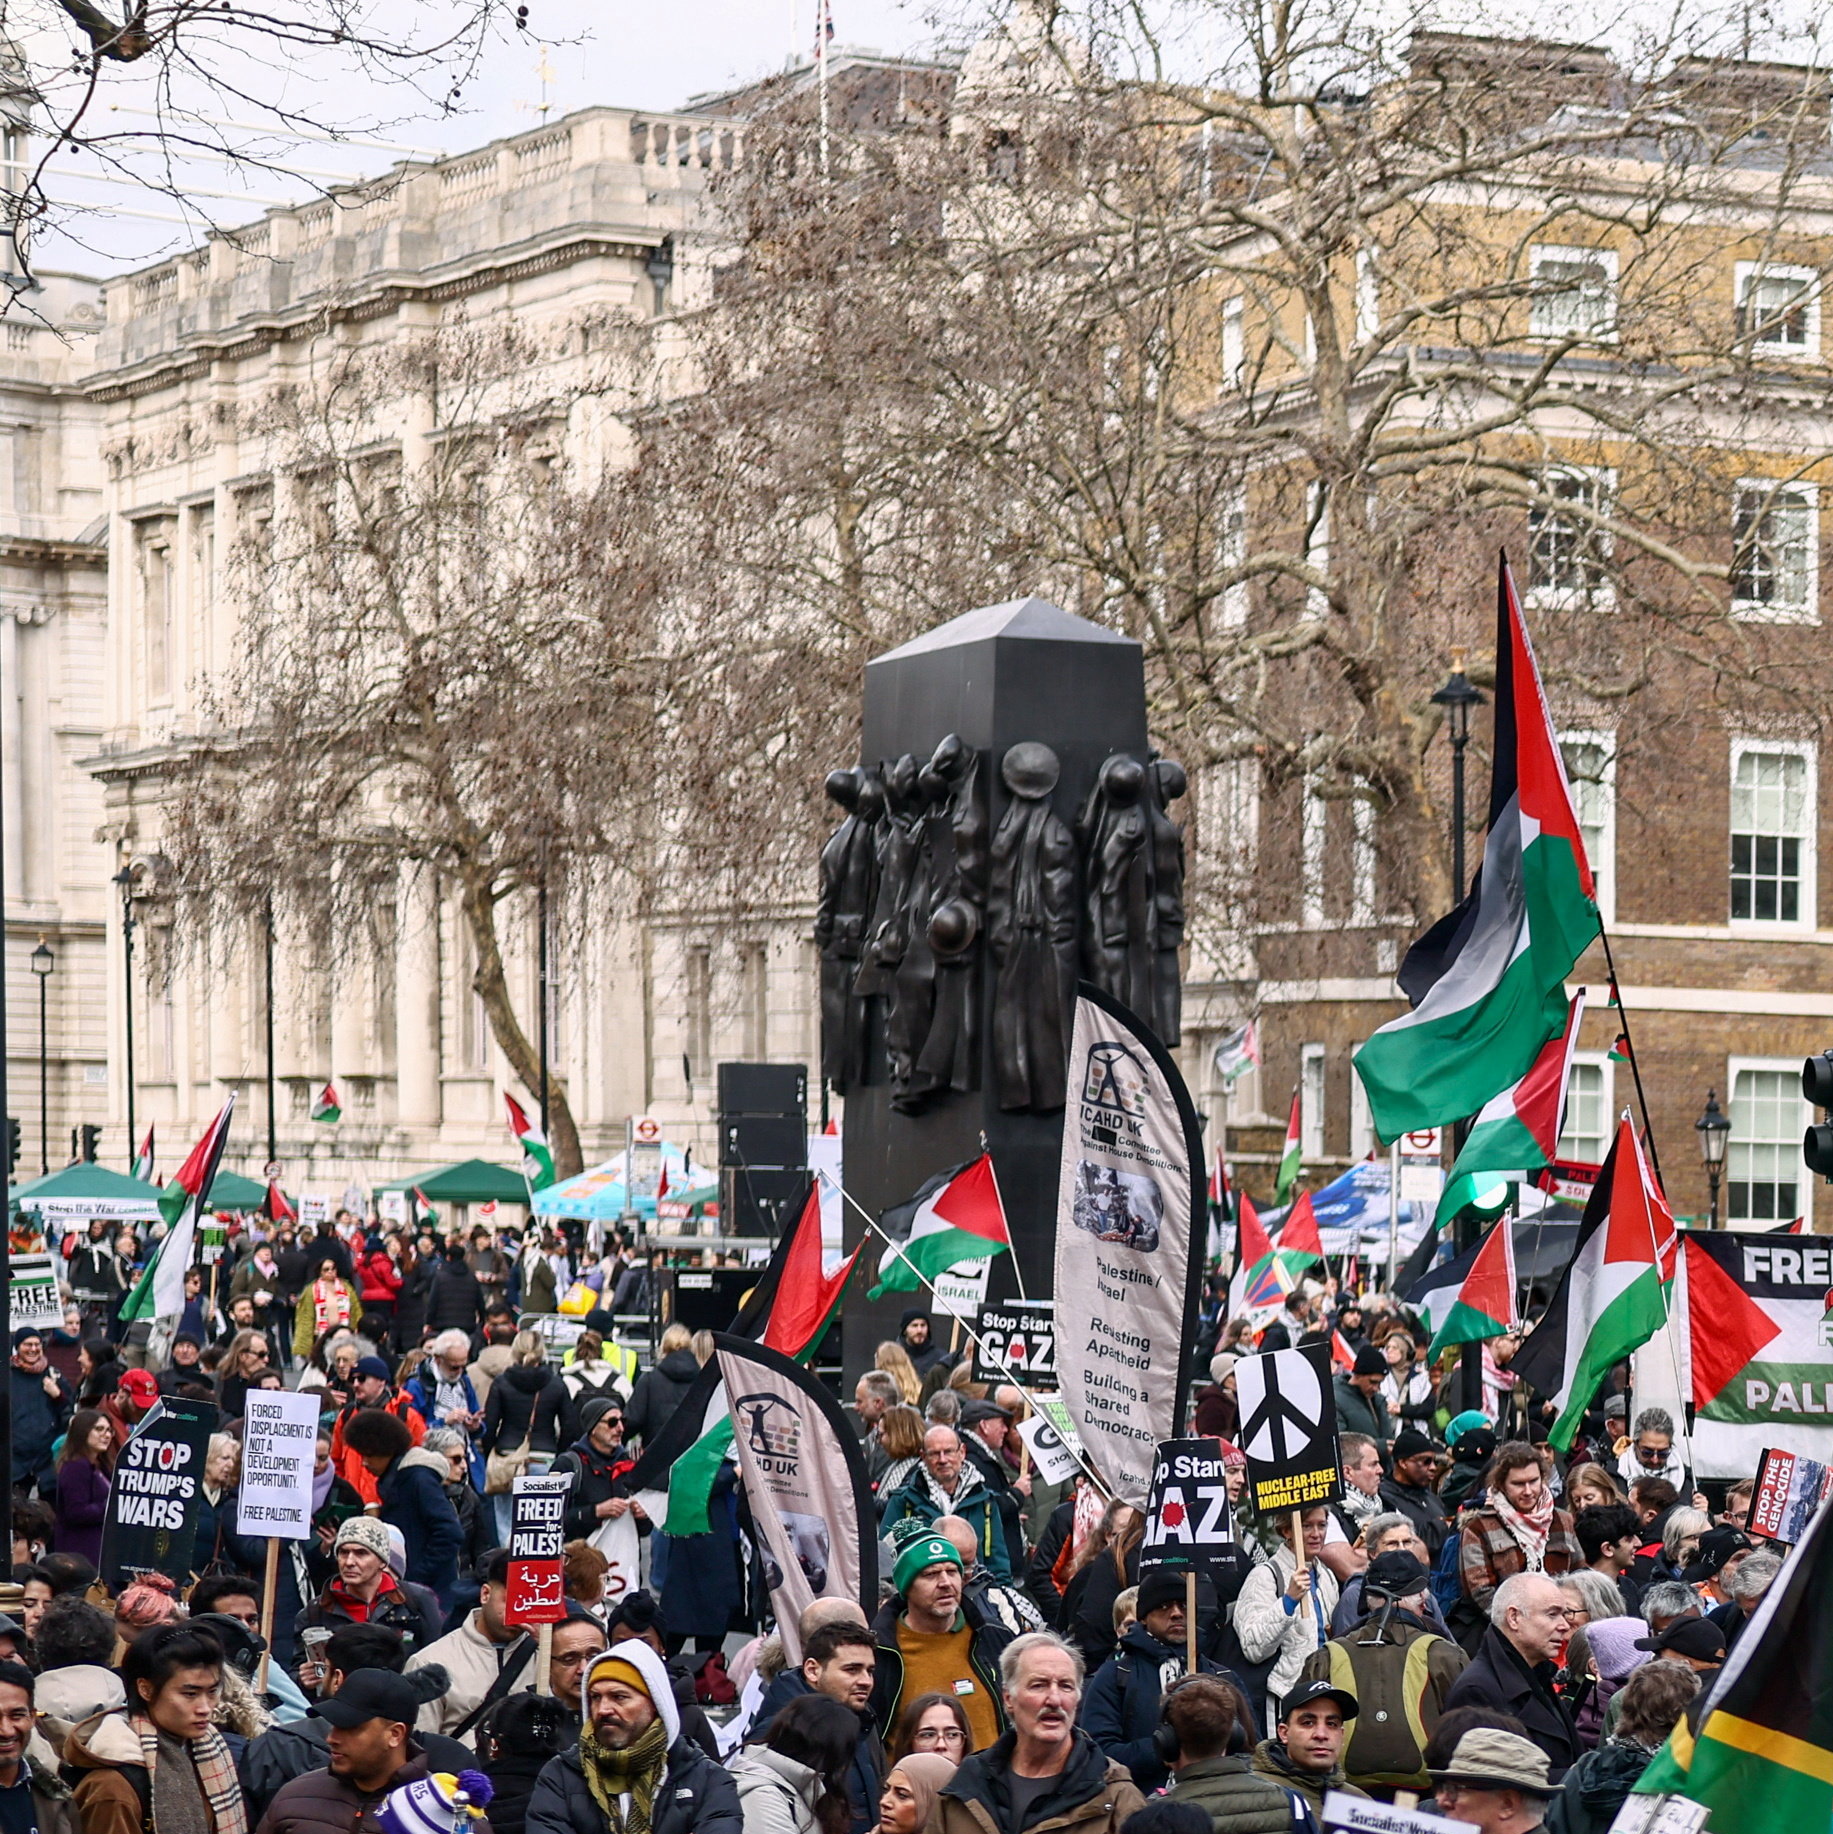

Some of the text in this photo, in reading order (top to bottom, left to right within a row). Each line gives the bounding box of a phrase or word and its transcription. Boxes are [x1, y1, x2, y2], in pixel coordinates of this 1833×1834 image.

[1080, 1105, 1122, 1129] ICAHD
[1096, 1256, 1153, 1286] Palestine
[938, 1284, 982, 1301] ISRAEL
[1097, 1276, 1126, 1302] Israel
[982, 1311, 1017, 1333] Stop
[978, 1330, 1057, 1373] GAZ
[1084, 1370, 1137, 1402] Building
[251, 1403, 283, 1419] FORCED
[1085, 1390, 1130, 1416] Shared
[250, 1420, 313, 1439] DISPLACEMENT IS
[127, 1437, 192, 1472] STOP
[248, 1437, 272, 1453] NOT A
[247, 1454, 300, 1472] DEVELOPMENT
[776, 1462, 799, 1476] UK
[118, 1468, 195, 1499] TRUMP'S
[246, 1472, 300, 1489] OPPORTUNITY.
[523, 1481, 558, 1492] Socialist
[1256, 1467, 1336, 1496] NUCLEAR-FREE
[1756, 1458, 1780, 1526] STOP THE
[1258, 1483, 1330, 1511] MIDDLE EAST
[1768, 1458, 1792, 1532] GENOCIDE
[117, 1494, 184, 1530] WARS
[244, 1505, 264, 1520] FREE
[546, 1521, 558, 1532] for
[1347, 1808, 1407, 1834] Socialist
